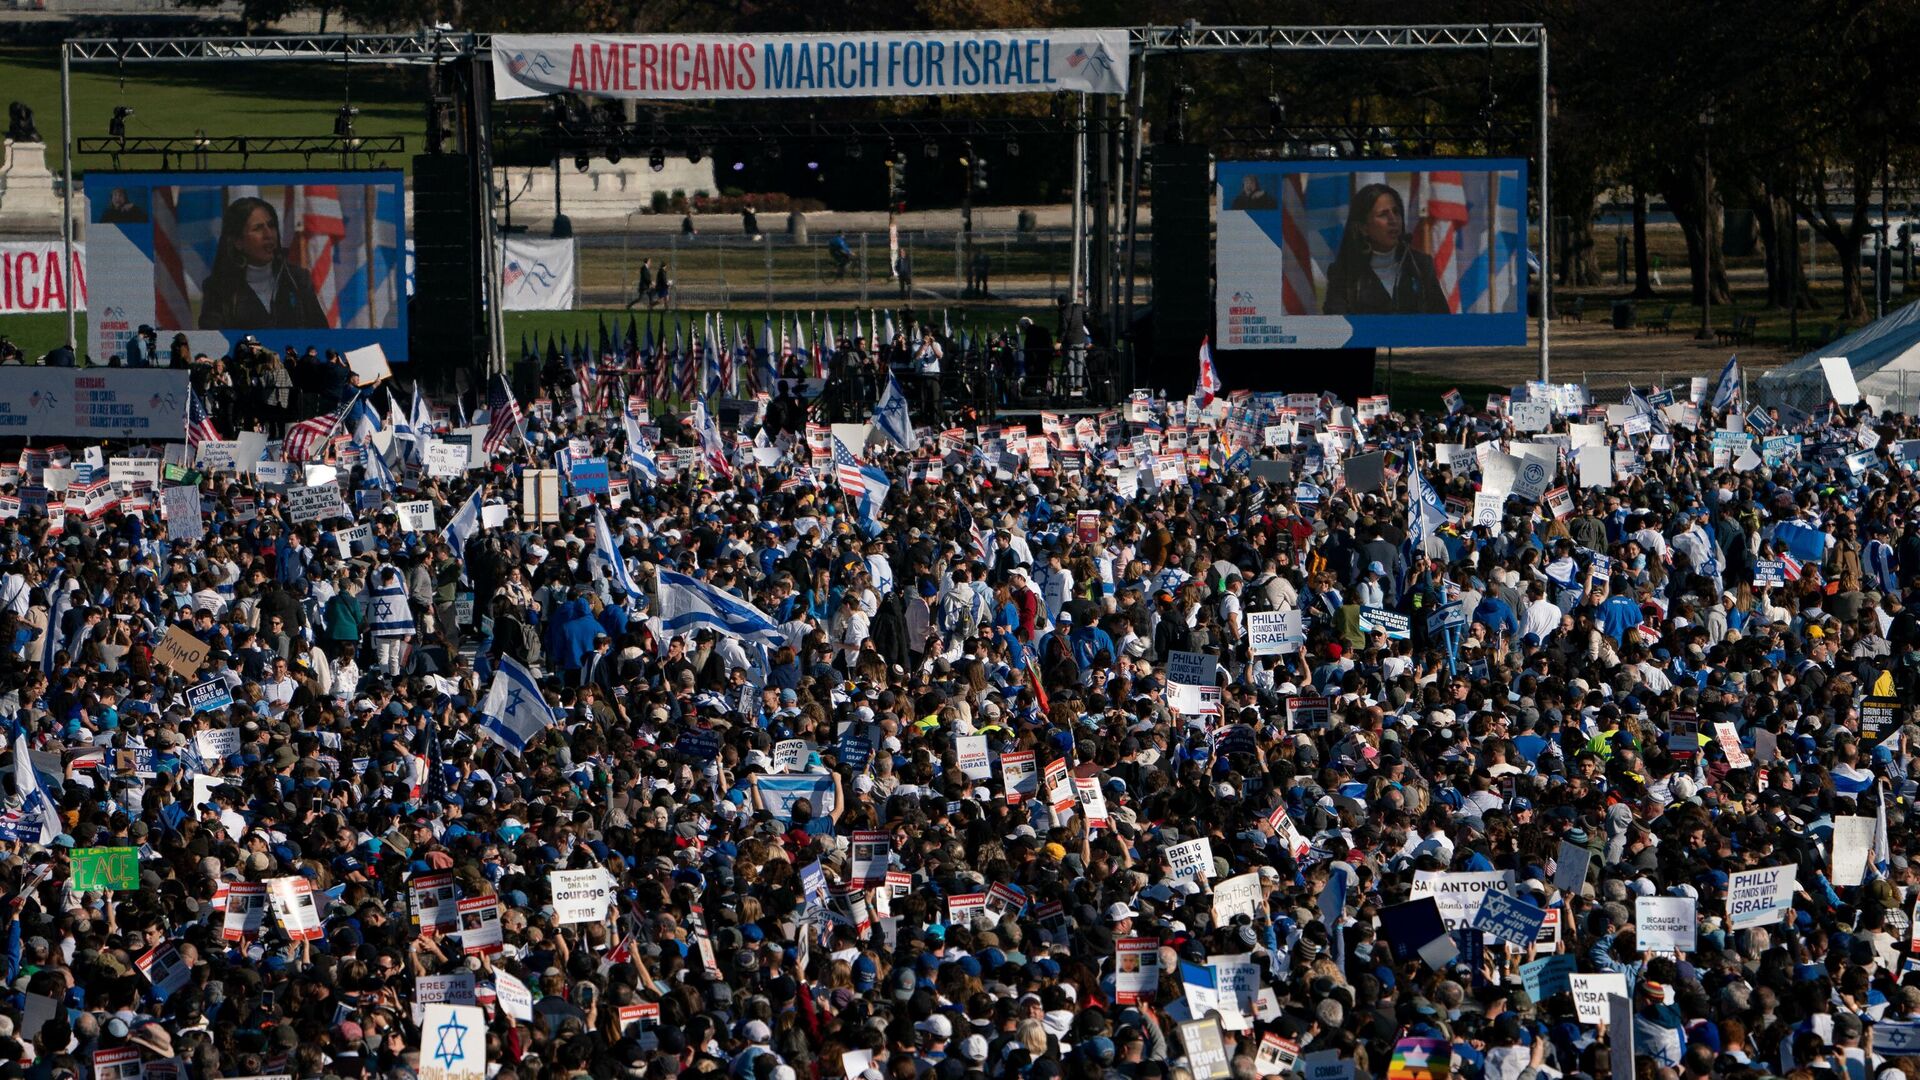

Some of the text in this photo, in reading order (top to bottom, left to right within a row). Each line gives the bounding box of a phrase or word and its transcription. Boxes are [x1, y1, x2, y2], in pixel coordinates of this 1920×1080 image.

[569, 39, 1057, 91] AMERICANS MARCH FOR ISRAEL
[0, 251, 88, 309] ICAN
[411, 503, 429, 514] FIDF
[350, 527, 368, 540] FIDF
[1252, 614, 1286, 624] PHILLY
[1362, 612, 1408, 626] STANDS WITH
[1371, 608, 1408, 621] CLEVELAND
[1252, 623, 1287, 632] STANDS WITH
[1385, 621, 1408, 631] ISRAEL
[1252, 633, 1288, 643] ISRAEL
[1172, 653, 1205, 665] PHILLY
[1171, 664, 1190, 673] STANDS
[1169, 673, 1204, 685] ISRAEL
[196, 683, 216, 696] LET MY
[193, 692, 215, 705] PEOPLE
[216, 688, 224, 696] GO
[1882, 708, 1893, 716] THE
[1863, 716, 1892, 724] HOSTAGES
[1862, 724, 1880, 732] HOME.
[777, 741, 802, 751] BRING
[776, 750, 797, 758] THEM
[1003, 753, 1034, 762] KIDNAPPED
[775, 757, 797, 767] HOME
[961, 761, 988, 770] ISRAEL
[16, 825, 39, 833] ISRAEL
[1172, 853, 1203, 868] THEM
[71, 854, 133, 888] PEACE
[573, 874, 597, 882] Jewish
[886, 875, 910, 883] NAPPED
[1735, 871, 1779, 888] PHILLY
[1441, 880, 1508, 893] ANTONIO
[1732, 884, 1778, 900] STANDS WITH
[556, 888, 604, 900] courage
[459, 898, 496, 910] KIDNAPPED
[951, 897, 983, 905] KIDNAPPED
[1731, 896, 1776, 914] ISRAEL
[577, 908, 595, 918] FIDF
[1498, 904, 1511, 916] We
[1510, 910, 1540, 927] Stand
[1504, 917, 1525, 931] with
[1477, 917, 1530, 947] ISRAEL
[420, 981, 468, 990] FREE THE
[1221, 985, 1253, 993] ISRAEL
[1574, 979, 1588, 989] AM
[421, 991, 473, 1001] HOSTAGES
[1575, 991, 1606, 1003] YISRA
[621, 1008, 658, 1020] KIDNAPPED
[1579, 1005, 1600, 1016] CHAI
[96, 1050, 139, 1062] KIDNAPPED
